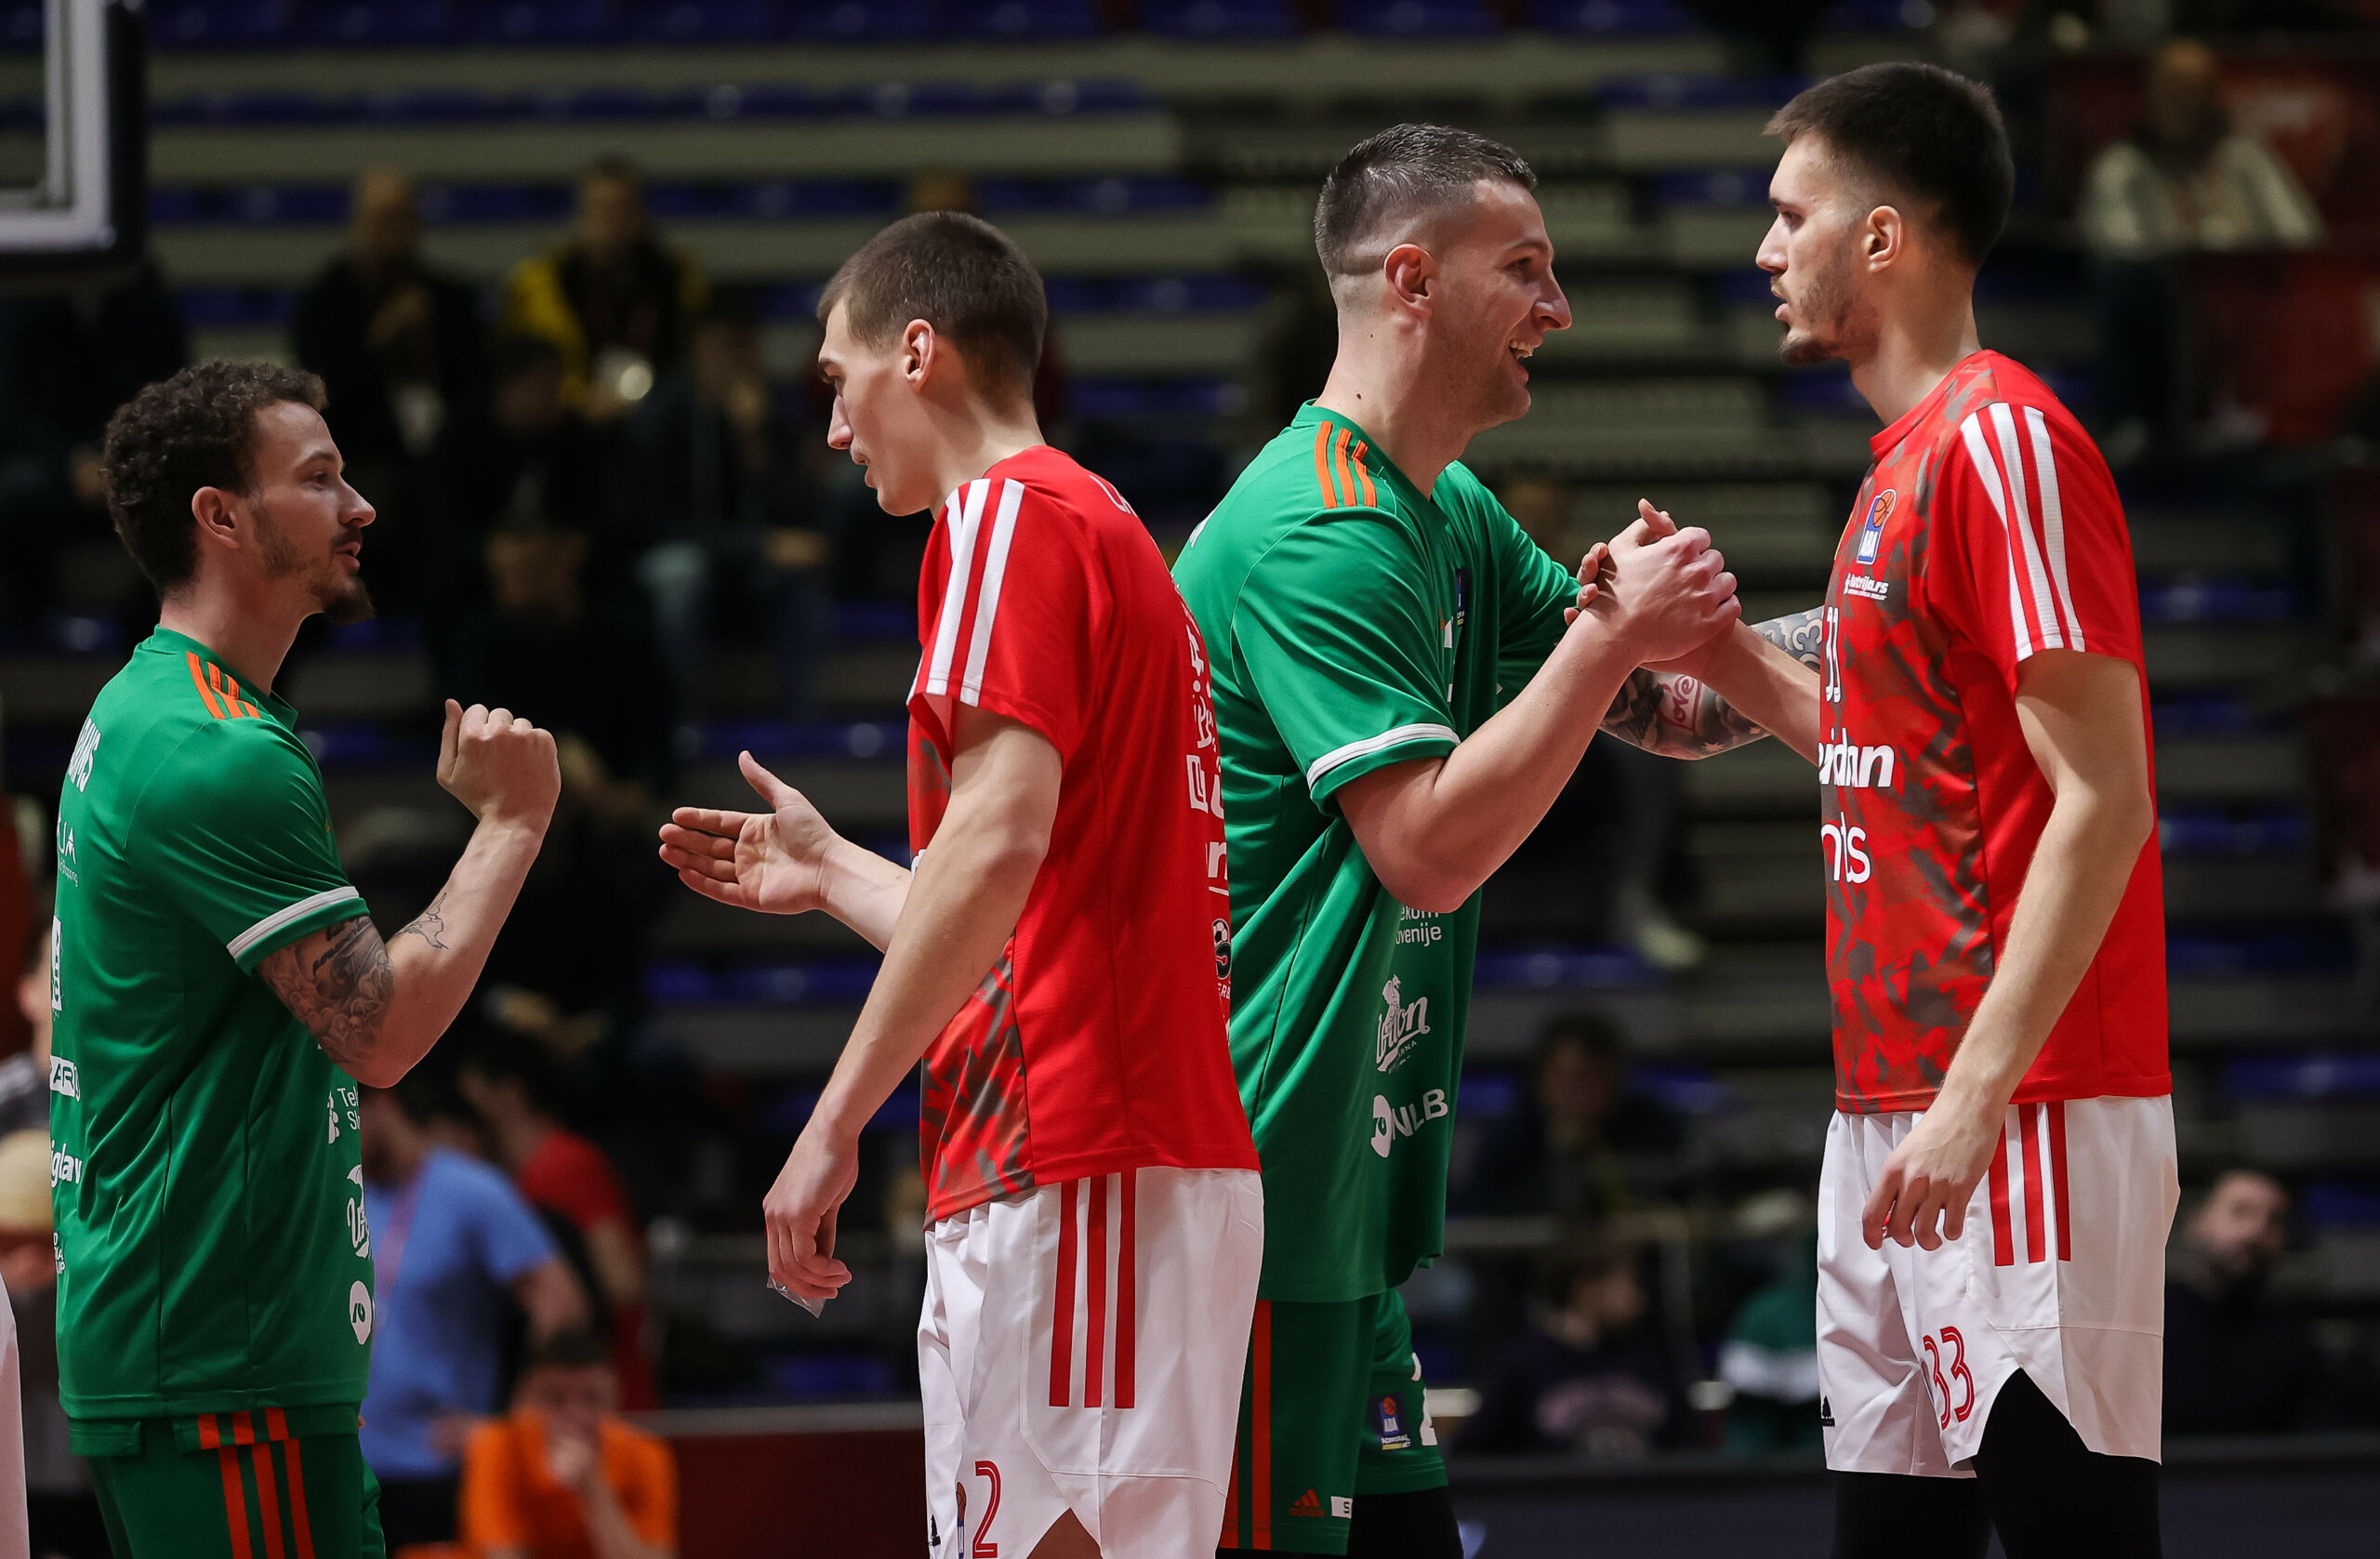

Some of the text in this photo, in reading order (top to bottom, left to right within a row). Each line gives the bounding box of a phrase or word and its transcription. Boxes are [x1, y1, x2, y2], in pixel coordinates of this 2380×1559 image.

[1391, 1088, 1448, 1142] NLB
[1923, 1325, 1976, 1431] 33
[972, 1460, 1001, 1559] 2
